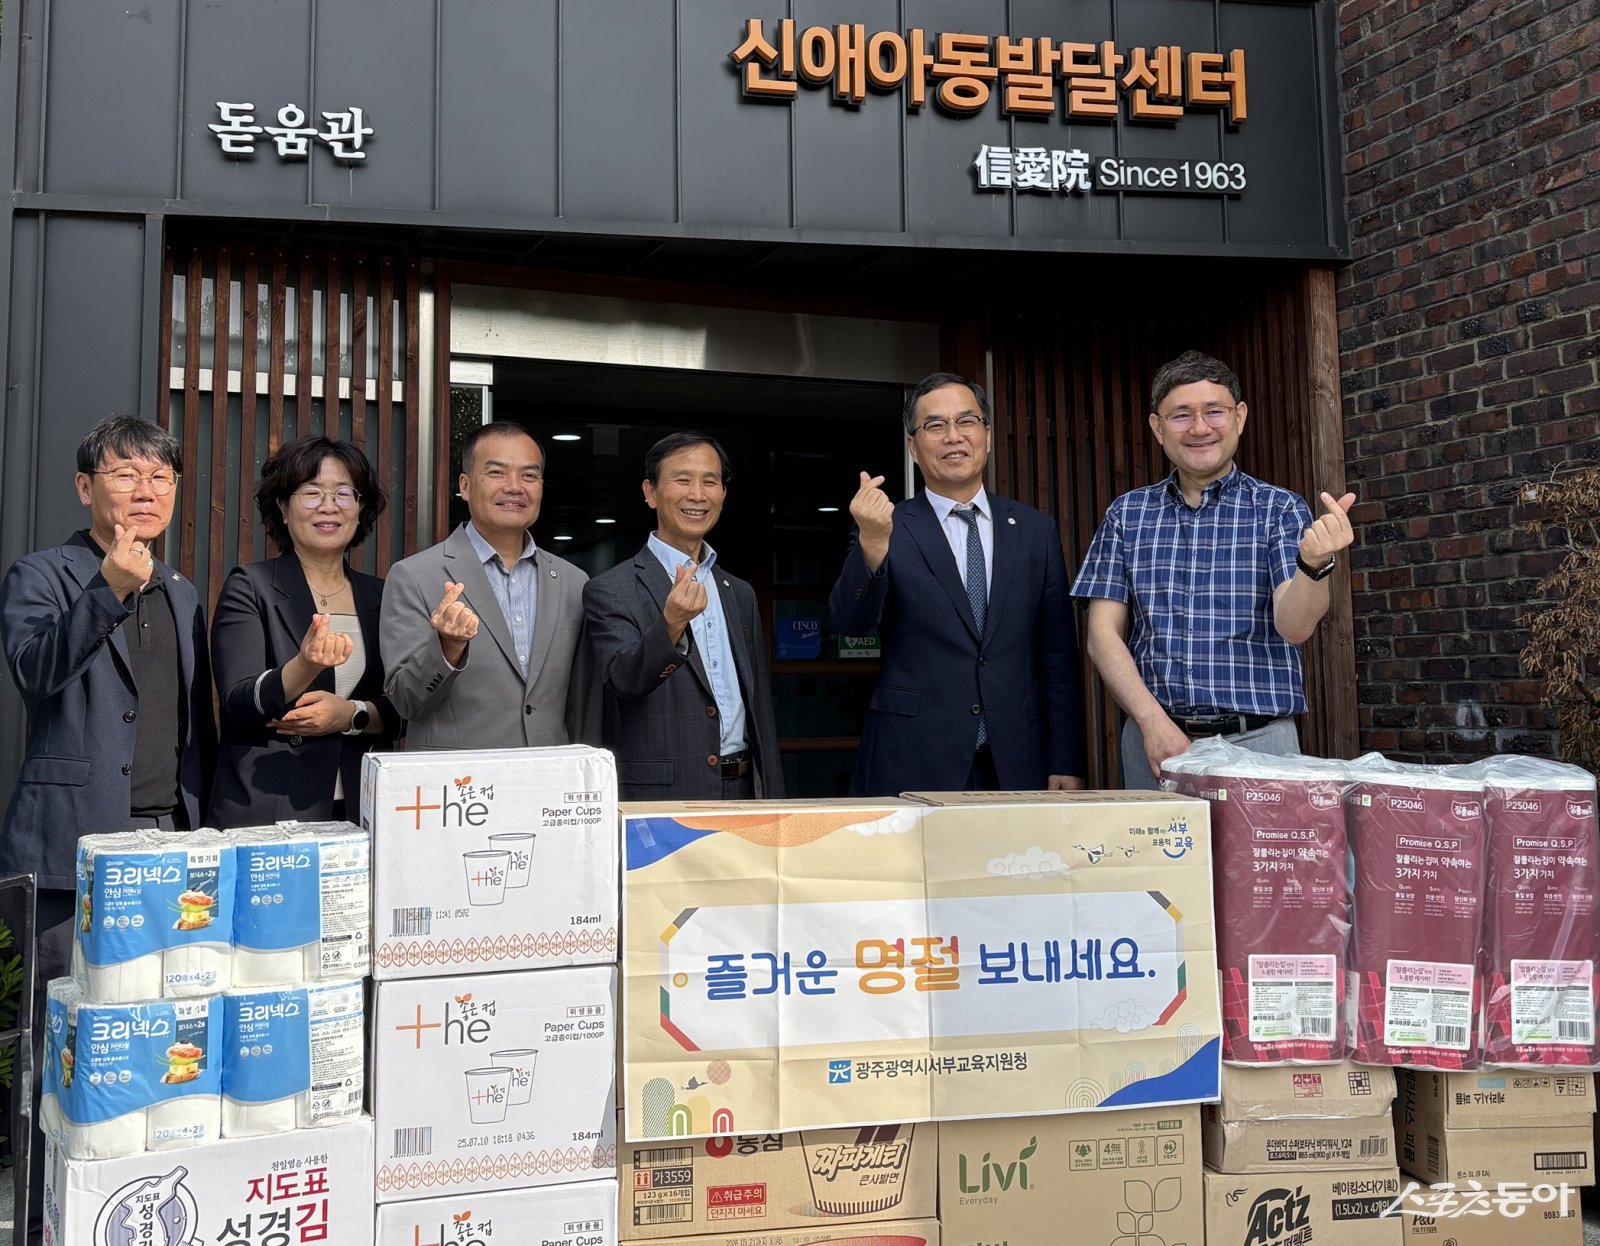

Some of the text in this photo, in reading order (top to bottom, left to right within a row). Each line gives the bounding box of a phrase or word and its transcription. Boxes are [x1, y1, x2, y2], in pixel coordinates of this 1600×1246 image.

[733, 19, 1247, 123] 신애아동발달센터
[208, 102, 374, 158] 돋움관
[973, 145, 1091, 191] 信愛院
[793, 621, 818, 631] CESCO
[857, 637, 876, 646] AED
[456, 783, 494, 803] 좋은 컵
[1246, 792, 1281, 802] P25046
[542, 806, 602, 818] Paper Cups
[1390, 800, 1423, 811] P25046
[1506, 801, 1538, 811] P25046
[542, 817, 602, 827] 고급종이컵/1000P
[1168, 822, 1188, 834] 서부
[1256, 831, 1315, 840] Promise Q.S.P
[1152, 836, 1193, 850] 포용적 교육
[1400, 837, 1458, 849] Promise Q.S.P
[1516, 838, 1573, 849] Promise Q.S.P
[1252, 847, 1330, 860] 잘풀리는집이 약속하는
[250, 853, 311, 872] 크리넥스
[1252, 860, 1294, 872] 3가지 가치
[1395, 854, 1472, 869] 잘풀리는집이 약속하는
[1513, 854, 1588, 867] 잘풀리는집이 약속하는
[104, 865, 182, 886] 크리넥스
[250, 872, 265, 882] 안심
[1395, 868, 1437, 880] 3가지 가치
[1513, 868, 1555, 880] 3가지 가치
[104, 887, 121, 899] 안심
[435, 910, 451, 919] 11:41
[455, 908, 469, 918] 0502
[570, 915, 601, 925] 184ml
[704, 935, 1156, 1001] 즐거운 명절 보내세요.
[238, 1001, 300, 1022] 크리넥스
[457, 1000, 496, 1021] 좋은 컵
[90, 1018, 171, 1041] 크리넥스
[239, 1022, 254, 1033] 안심
[544, 1020, 604, 1033] Paper Cups
[544, 1031, 604, 1042] 고급종이컵/1000P
[91, 1042, 109, 1054] 안심
[855, 1053, 1028, 1080] 광주광역시서부교육지원청
[1456, 1092, 1506, 1105] 케라시스 퍼퓸
[457, 1131, 536, 1148] 25.07.10 18:18 0436
[571, 1131, 603, 1141] 184ml
[737, 1133, 783, 1154] 농심
[1266, 1139, 1288, 1151] 온더바디
[272, 1153, 329, 1172] 천일염을 사용한
[812, 1143, 907, 1182] 짜파게티
[654, 1169, 692, 1185] 가3559
[859, 1172, 899, 1186] 큰사발면
[246, 1167, 330, 1205] 지도표
[1332, 1179, 1398, 1195] 베이킹소다(기획)
[135, 1192, 161, 1204] 지도표
[723, 1188, 762, 1202] 취급주의
[959, 1196, 998, 1207] Everyday
[711, 1206, 763, 1219] 던지지 마세요
[1244, 1186, 1311, 1246] Actz
[1335, 1202, 1363, 1217] (1.5Lx2)
[216, 1199, 329, 1246] 성경김
[567, 1221, 600, 1232] 위생용품
[1412, 1214, 1435, 1226] P&G
[453, 1219, 492, 1242] 좋은 컵
[576, 1236, 603, 1246] Cups
